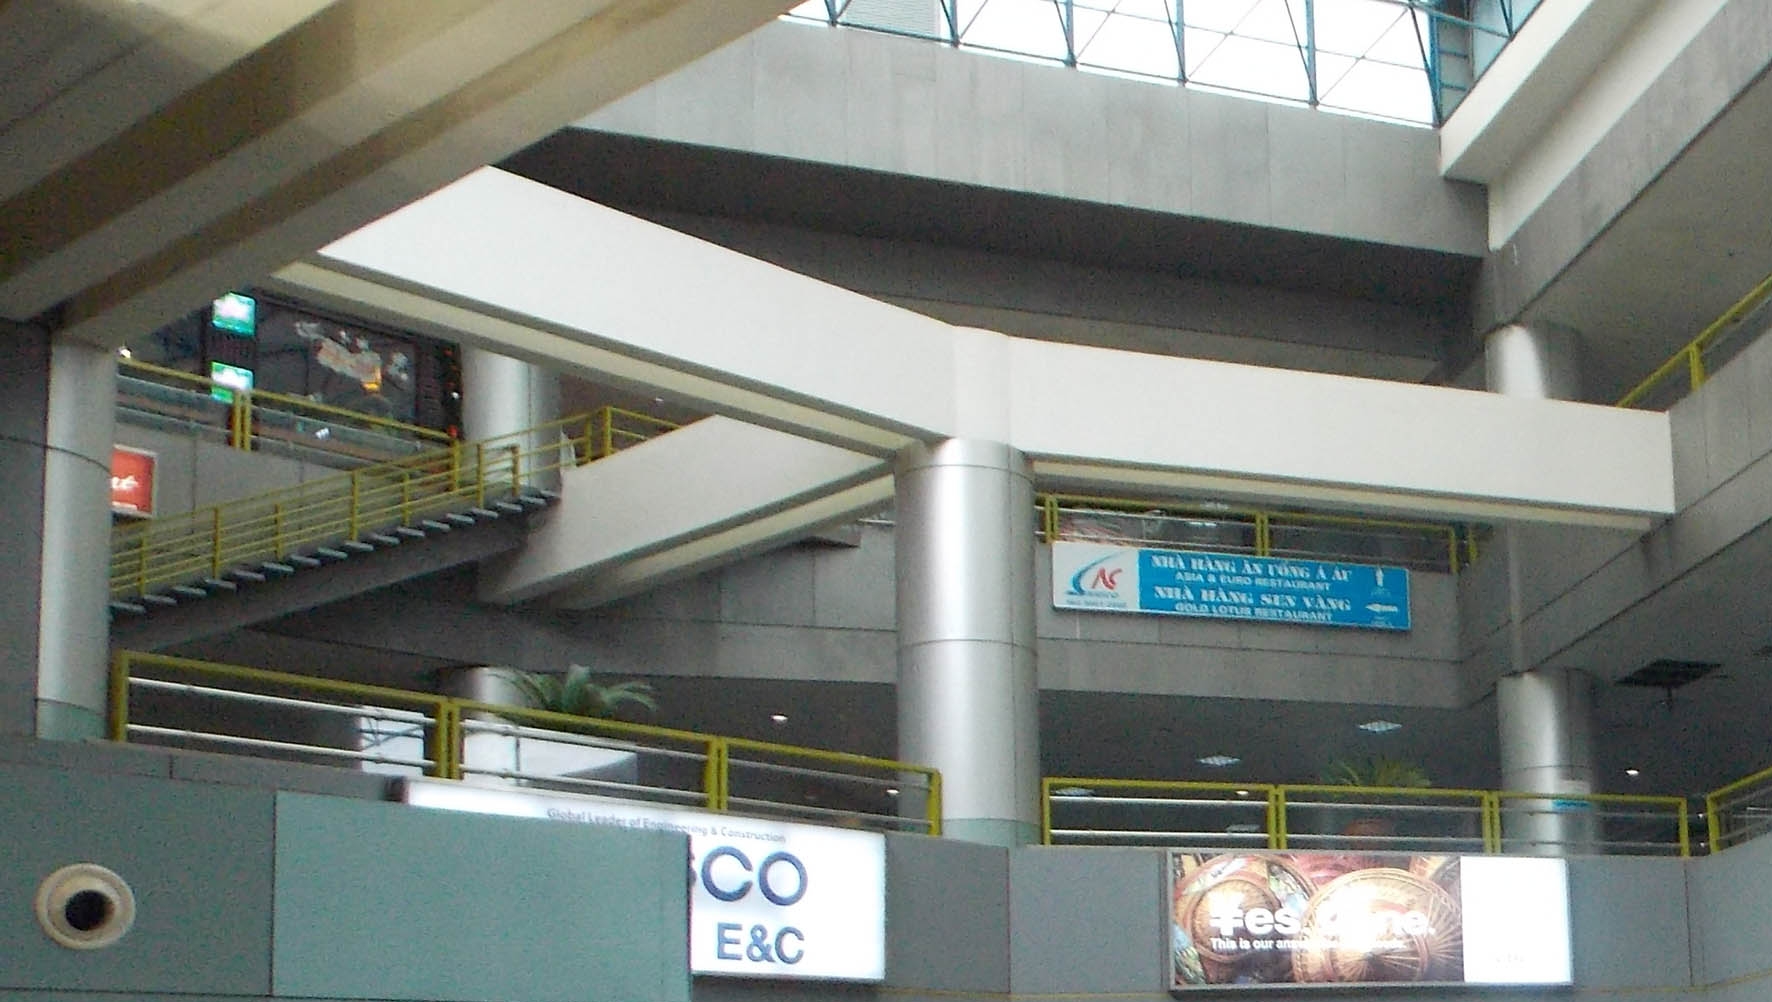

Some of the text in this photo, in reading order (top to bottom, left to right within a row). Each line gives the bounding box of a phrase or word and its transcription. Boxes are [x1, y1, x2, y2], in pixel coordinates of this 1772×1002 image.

[1254, 577, 1331, 592] RESTAURANT
[547, 808, 586, 822] Global
[721, 826, 787, 843] Construction
[692, 846, 808, 906] CO
[716, 922, 805, 965] E&C
[1211, 937, 1236, 952] This
[1239, 938, 1251, 951] is
[1252, 940, 1275, 951] our
